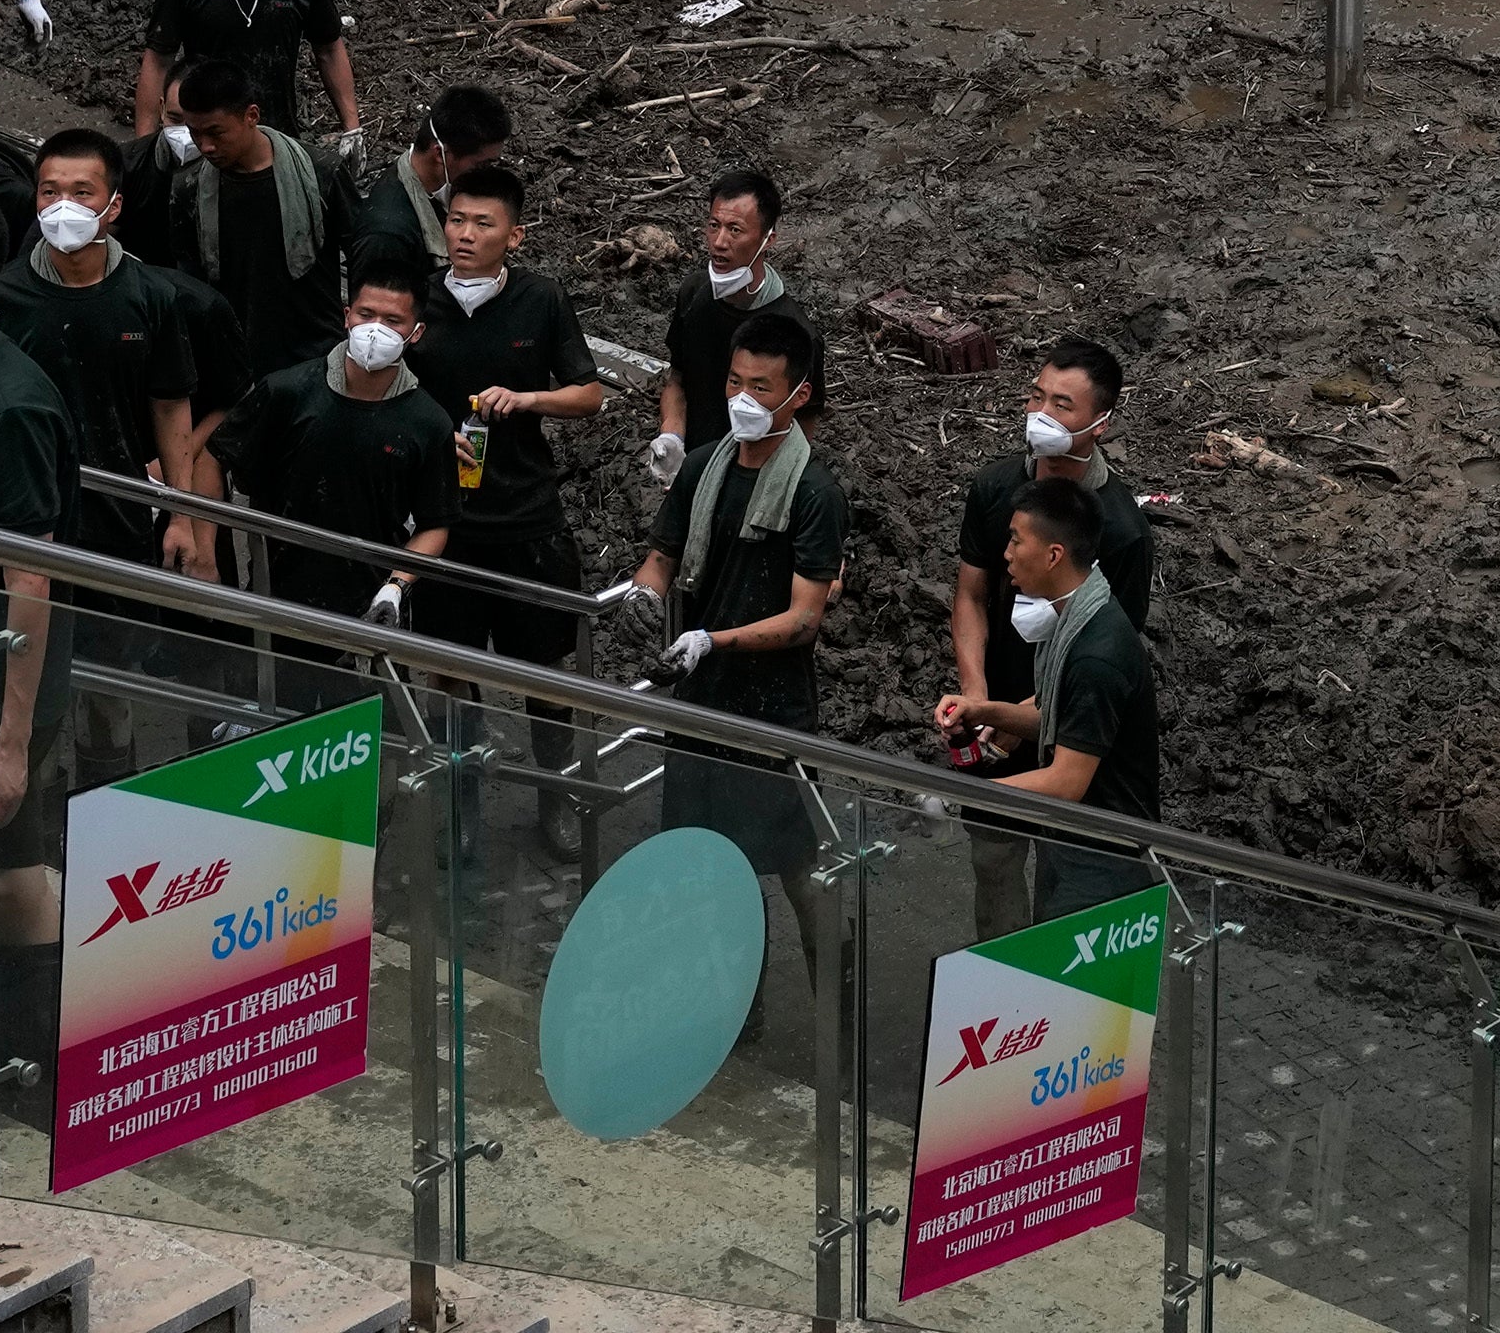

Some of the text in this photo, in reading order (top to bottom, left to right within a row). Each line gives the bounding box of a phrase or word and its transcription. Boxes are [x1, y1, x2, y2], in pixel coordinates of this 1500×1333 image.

[300, 729, 372, 786] kids
[151, 857, 233, 917] 特步
[282, 893, 338, 937] kids
[1104, 911, 1161, 957] kids
[97, 963, 339, 1077] 北京海立睿方工程有限公司
[989, 1017, 1051, 1065] 特步
[67, 996, 359, 1130] 承接各种工程装修设计主体结构施工
[108, 1046, 318, 1143] 15811119773 18810031600
[1083, 1053, 1126, 1091] kids
[941, 1114, 1122, 1202] 北京海立睿方工程有限公司
[916, 1144, 1135, 1246] 承接各种工程装修设计主体结构施工
[945, 1186, 1103, 1260] 15811119773 18810031600
